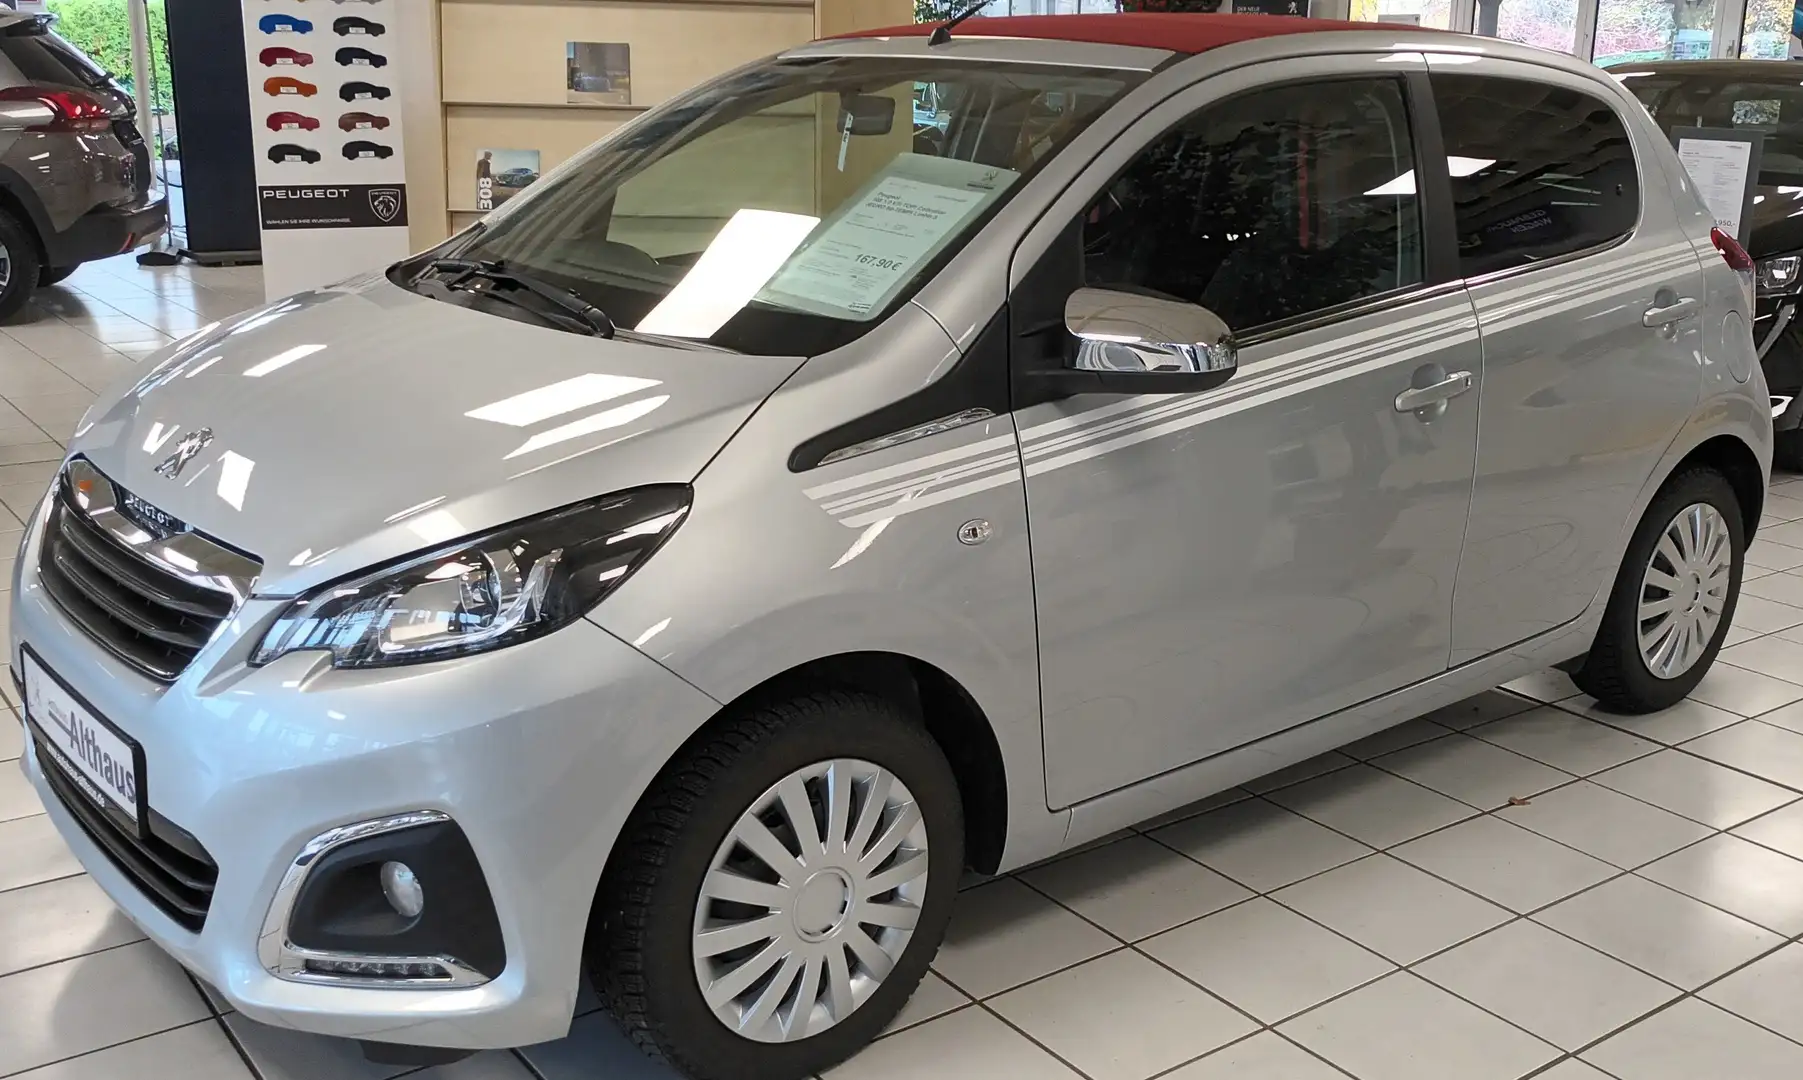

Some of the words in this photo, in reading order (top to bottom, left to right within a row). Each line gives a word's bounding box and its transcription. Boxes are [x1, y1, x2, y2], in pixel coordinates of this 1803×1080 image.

[262, 189, 350, 198] PEUGEOT
[480, 178, 492, 210] 308
[70, 710, 136, 804] Althaus
